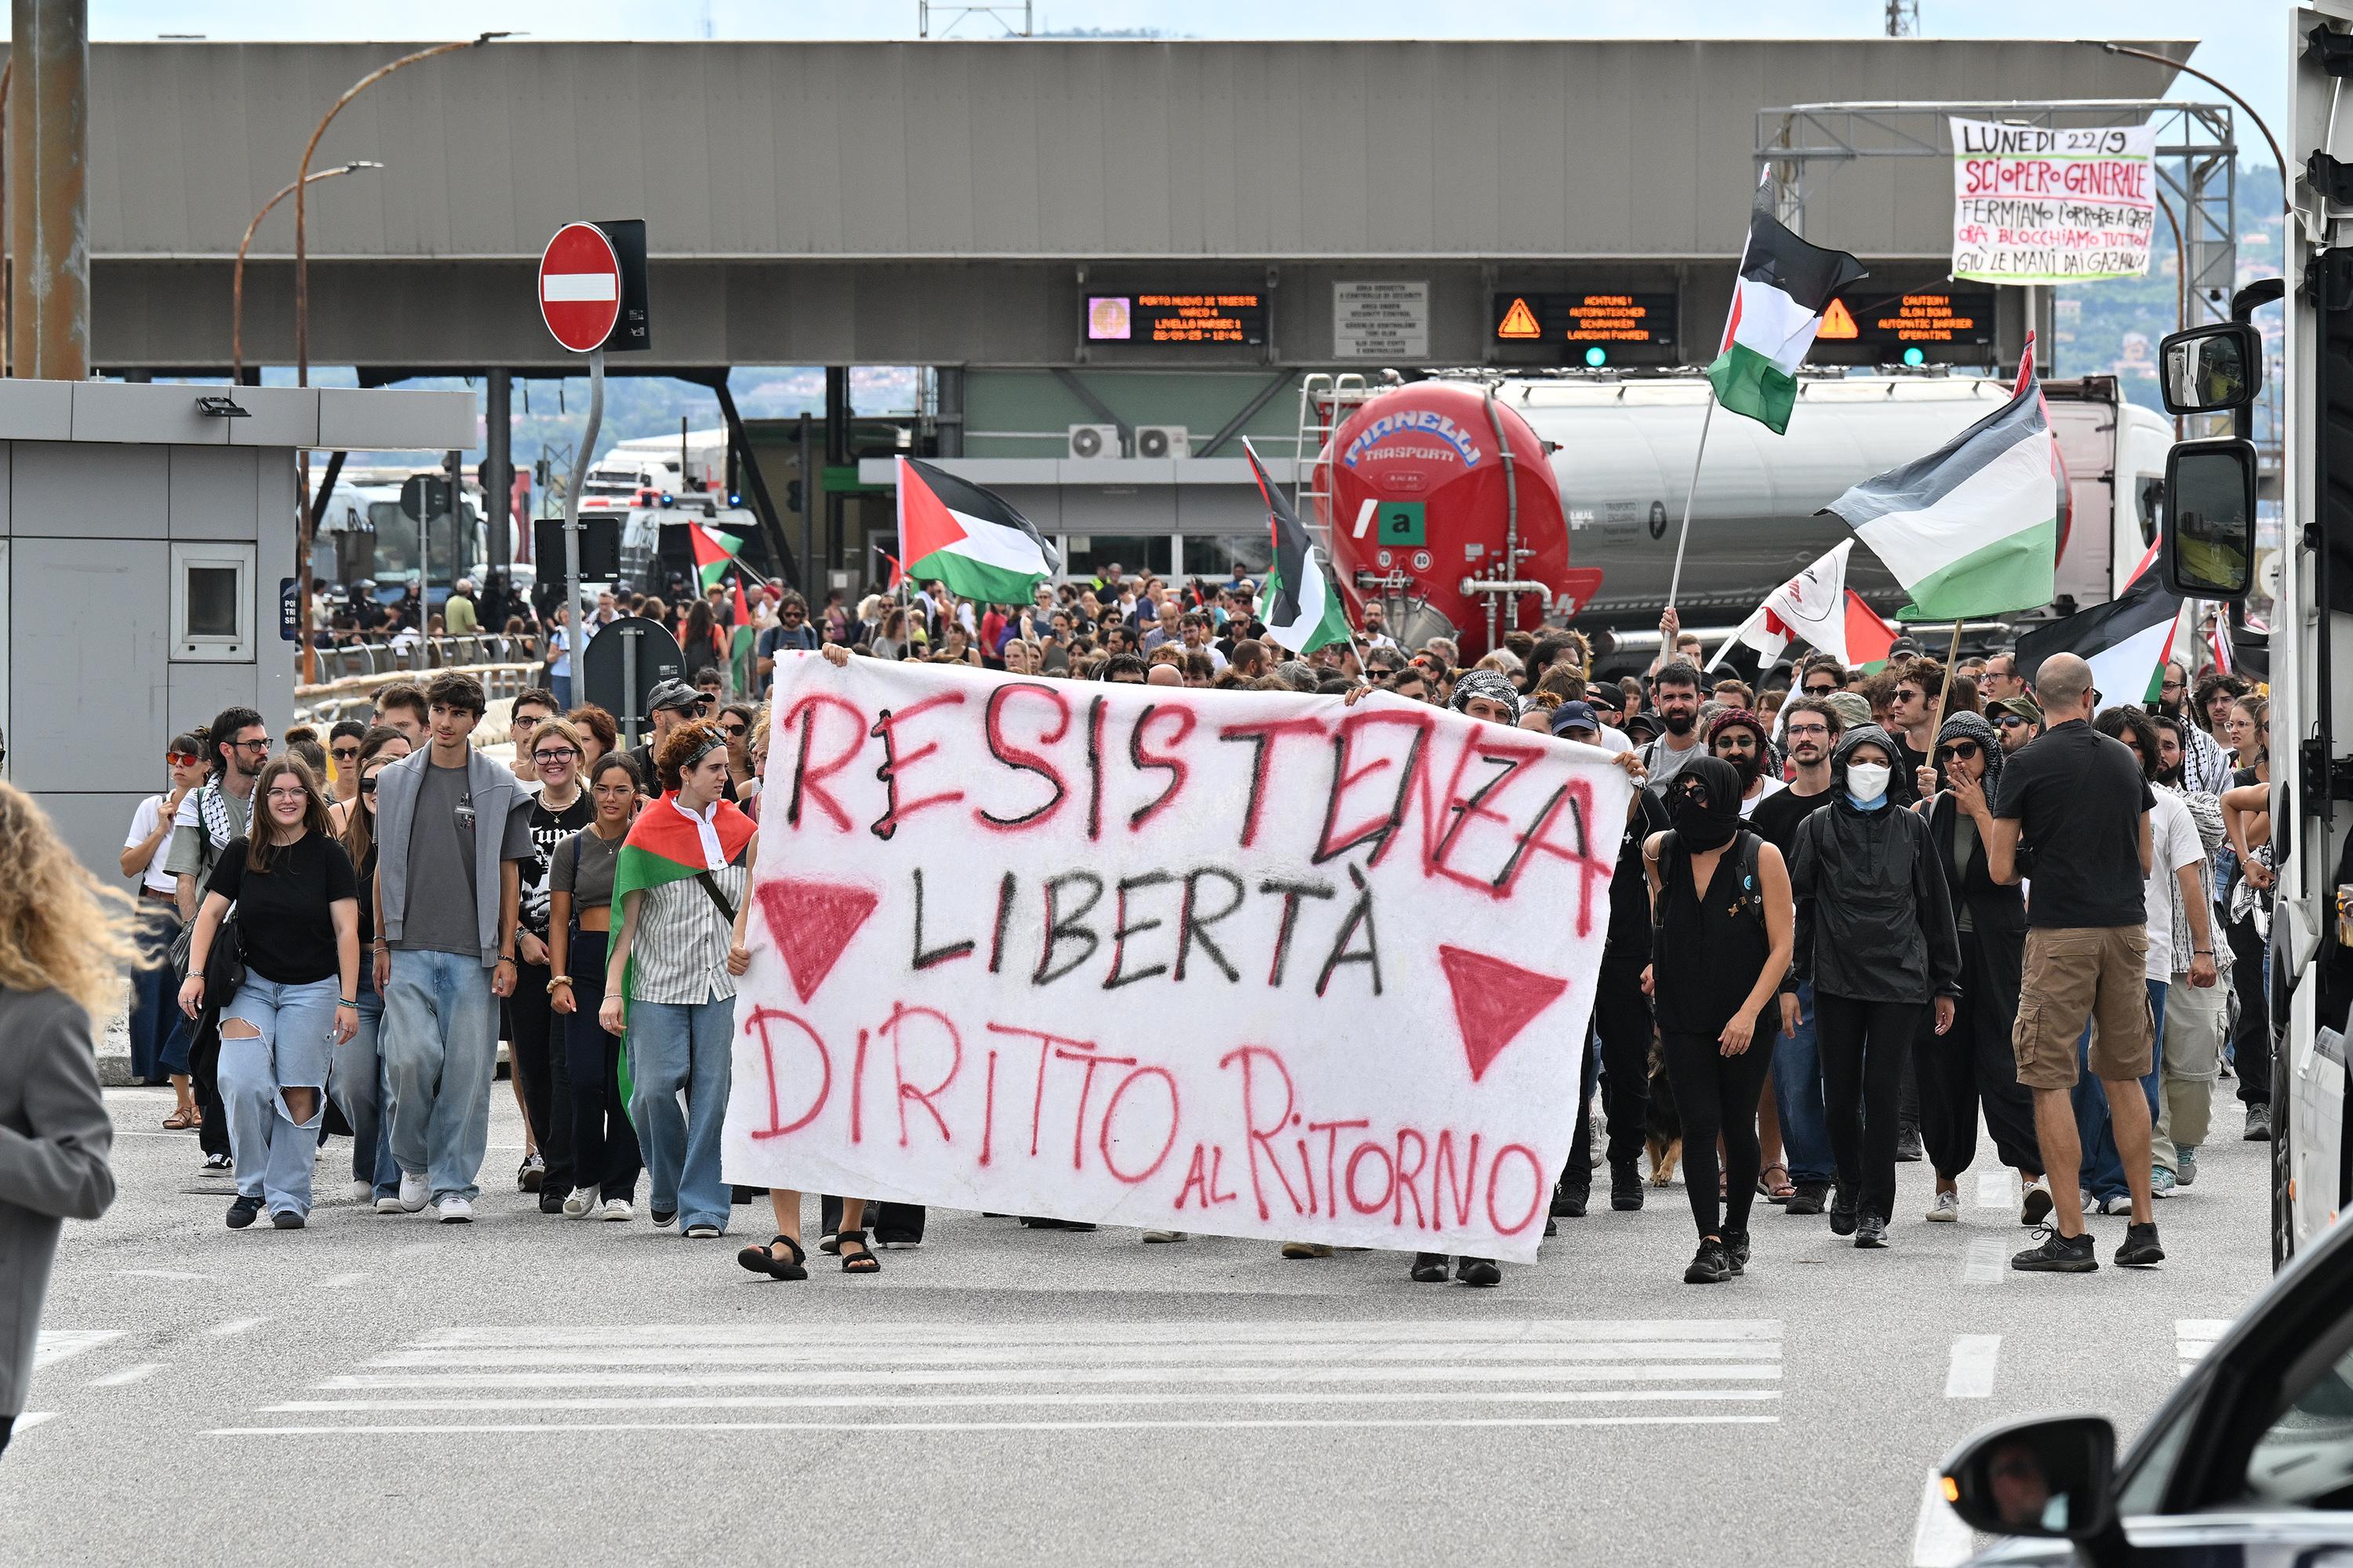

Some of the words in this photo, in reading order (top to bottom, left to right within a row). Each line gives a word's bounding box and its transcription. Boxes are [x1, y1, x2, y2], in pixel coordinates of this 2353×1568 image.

[2067, 130, 2126, 154] 22/9
[2064, 161, 2148, 200] GENERALE
[2116, 208, 2124, 225] A
[1958, 225, 1989, 243] ORA
[1990, 252, 2007, 271] LE
[1217, 295, 1258, 307] TRIESTE
[1584, 295, 1627, 306] ACHTUNG
[1903, 295, 1944, 306] CAUTION
[1178, 307, 1210, 318] VARCO
[1211, 307, 1218, 318] 4
[1900, 307, 1926, 318] SLOW
[1926, 307, 1952, 318] DOWN
[1155, 318, 1196, 329] LIVELLO
[1197, 318, 1235, 329] MARSEC
[1235, 318, 1241, 329] 1
[1878, 318, 1931, 329] AUTOMATIC
[1933, 318, 1974, 329] BARRIER
[1567, 329, 1611, 340] LANGSAM
[1611, 329, 1649, 340] FAHREN
[1899, 329, 1952, 340] OPERATING
[1365, 446, 1455, 462] TRASPORTI
[1392, 513, 1410, 533] a
[1417, 555, 1427, 565] 80
[783, 680, 1612, 937] RESISTENZA
[911, 863, 1384, 998] LIBERTÀ
[744, 1000, 1181, 1184] DIRITTO
[1173, 1144, 1237, 1210] AL
